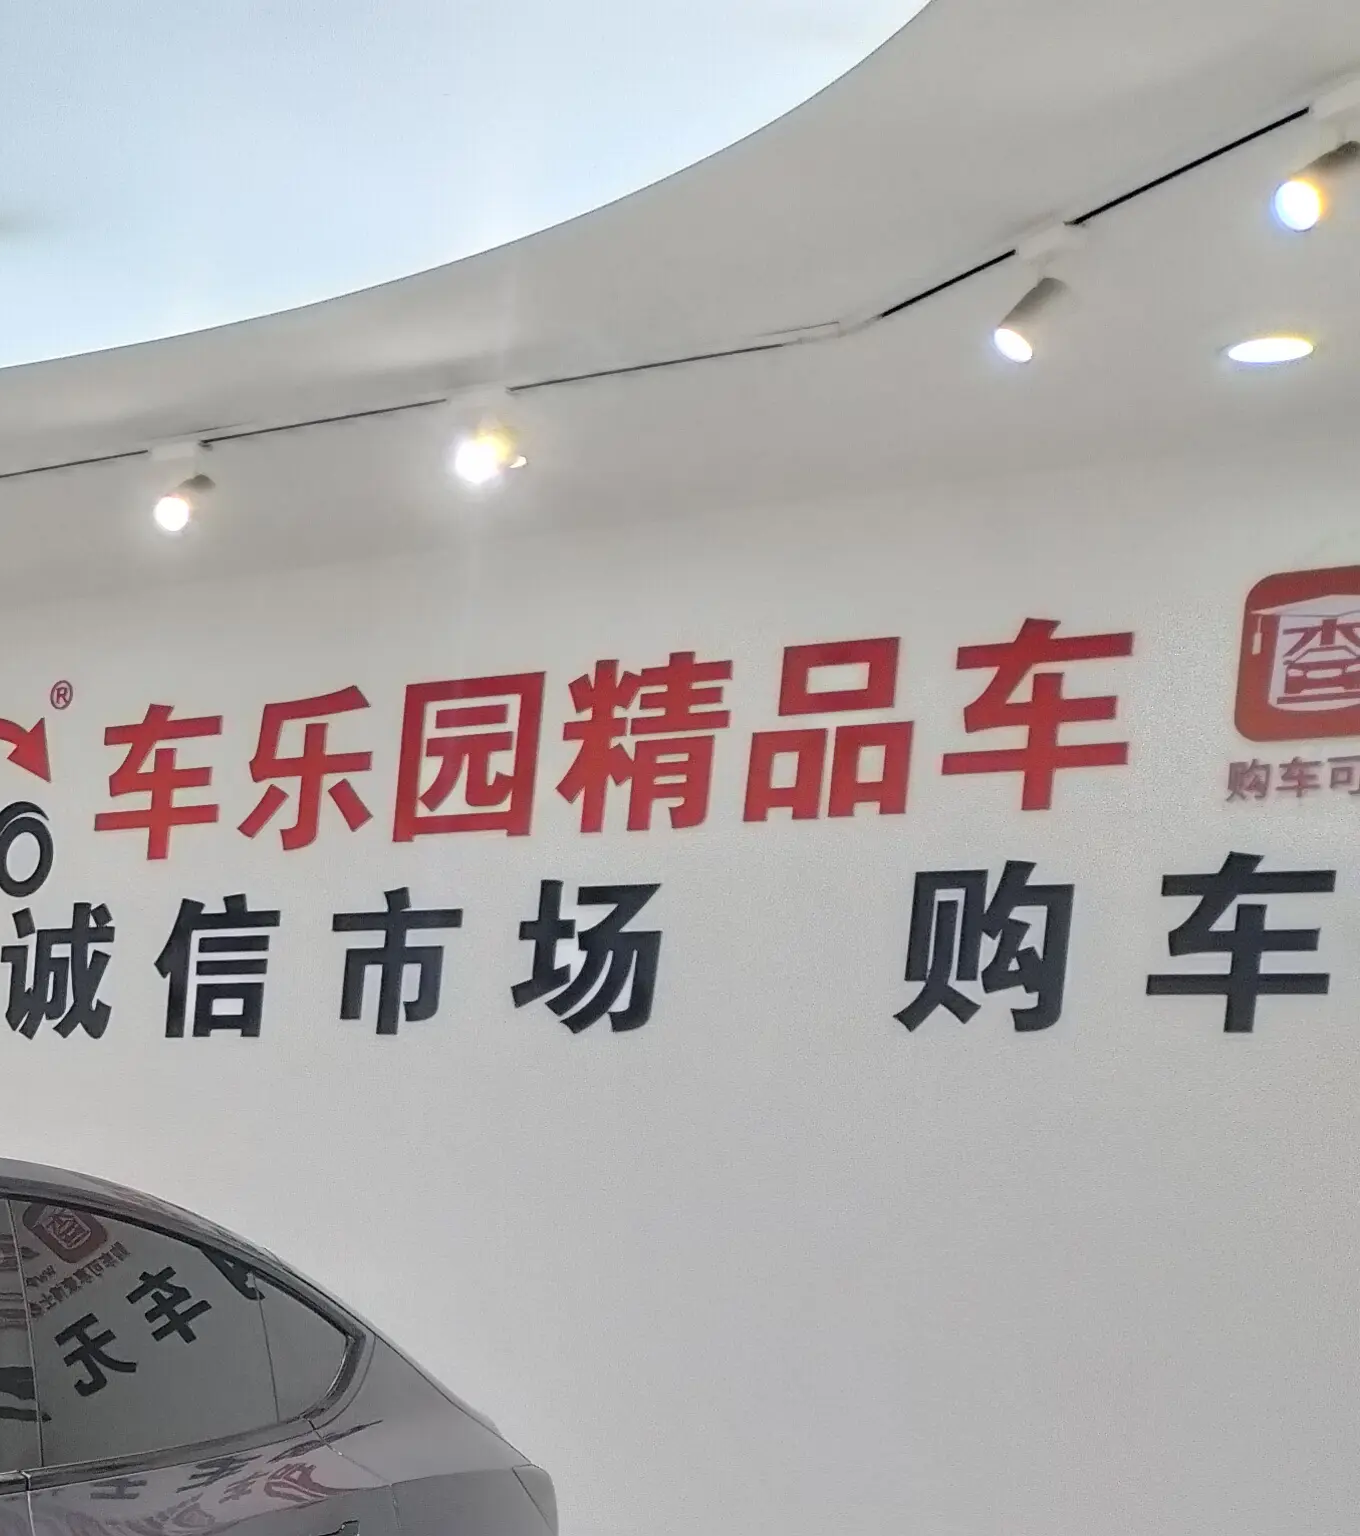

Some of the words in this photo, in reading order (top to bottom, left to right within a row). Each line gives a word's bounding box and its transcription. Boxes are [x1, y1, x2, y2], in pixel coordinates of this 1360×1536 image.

[94, 618, 1133, 860] 车乐园精品车
[0, 879, 662, 1040] 诚信市场
[892, 851, 1337, 1033] 购车
